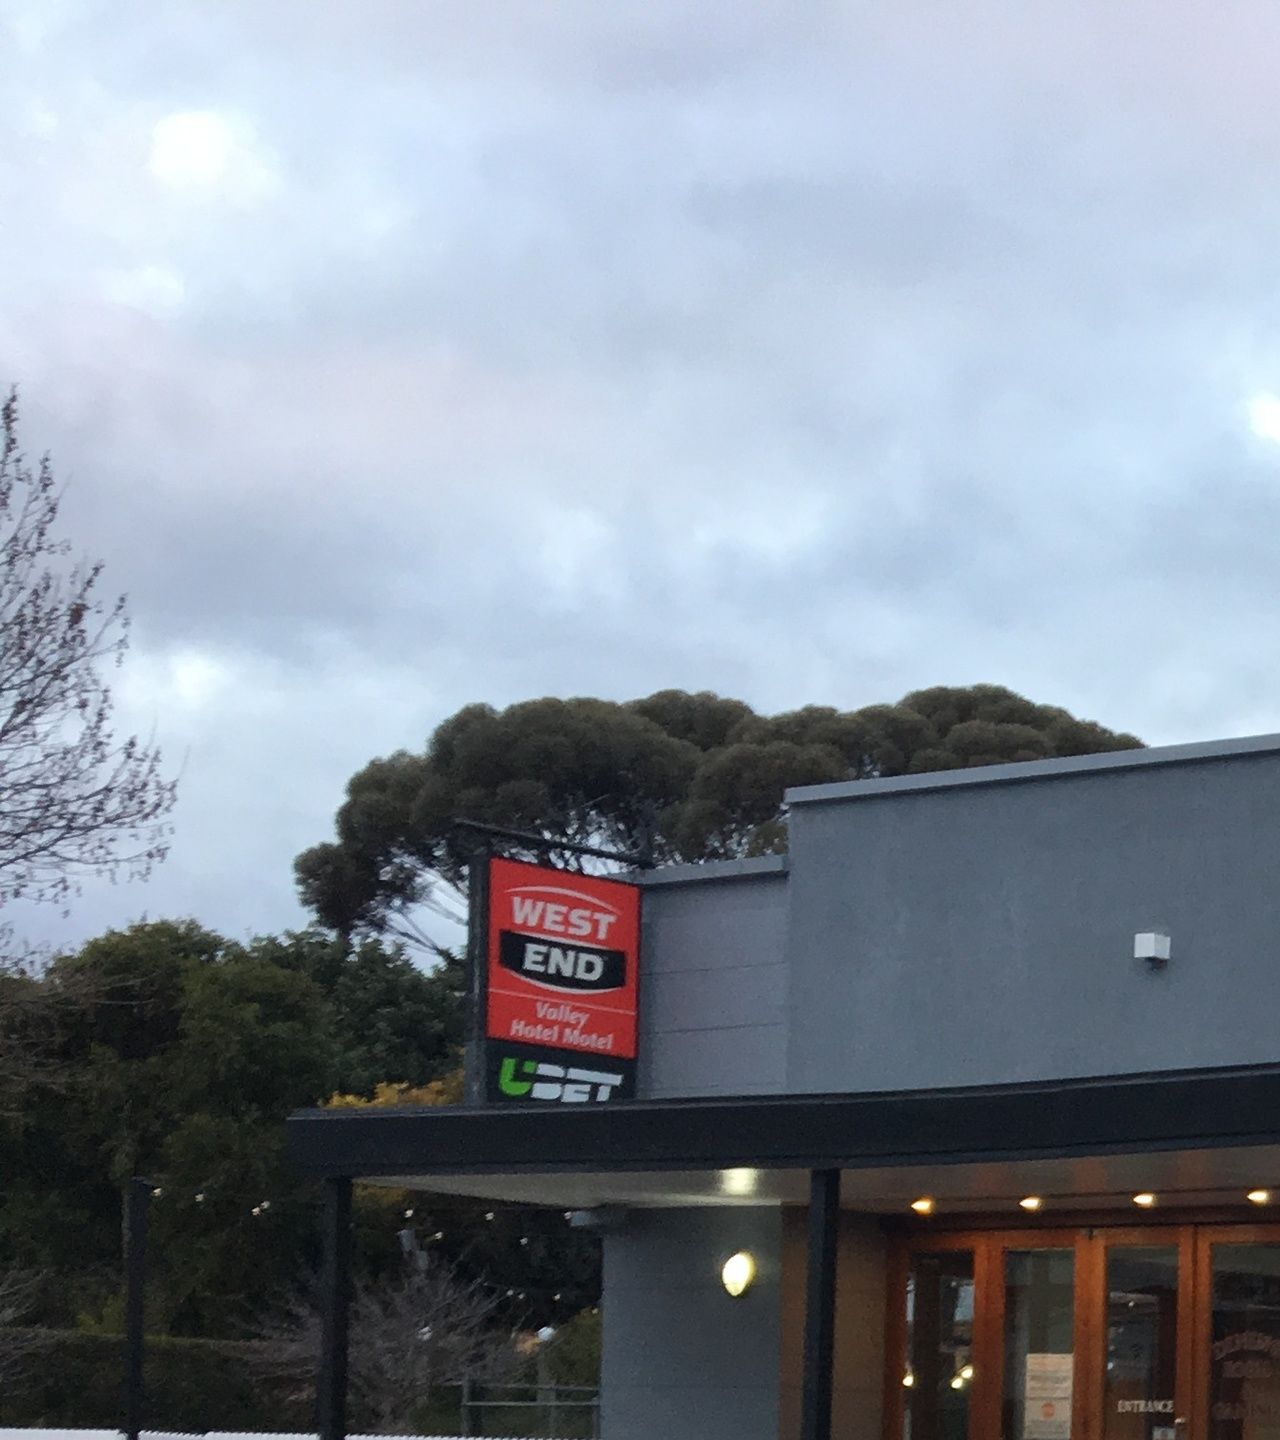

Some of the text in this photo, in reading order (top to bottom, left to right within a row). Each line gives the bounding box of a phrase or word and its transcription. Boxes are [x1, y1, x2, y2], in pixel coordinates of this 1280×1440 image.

[511, 896, 617, 940] WEST
[522, 943, 604, 982] END
[536, 1001, 590, 1029] Valley
[510, 1019, 613, 1050] Hotel Motel
[501, 1057, 623, 1103] UBET
[1117, 1399, 1175, 1413] ENTRANCE
